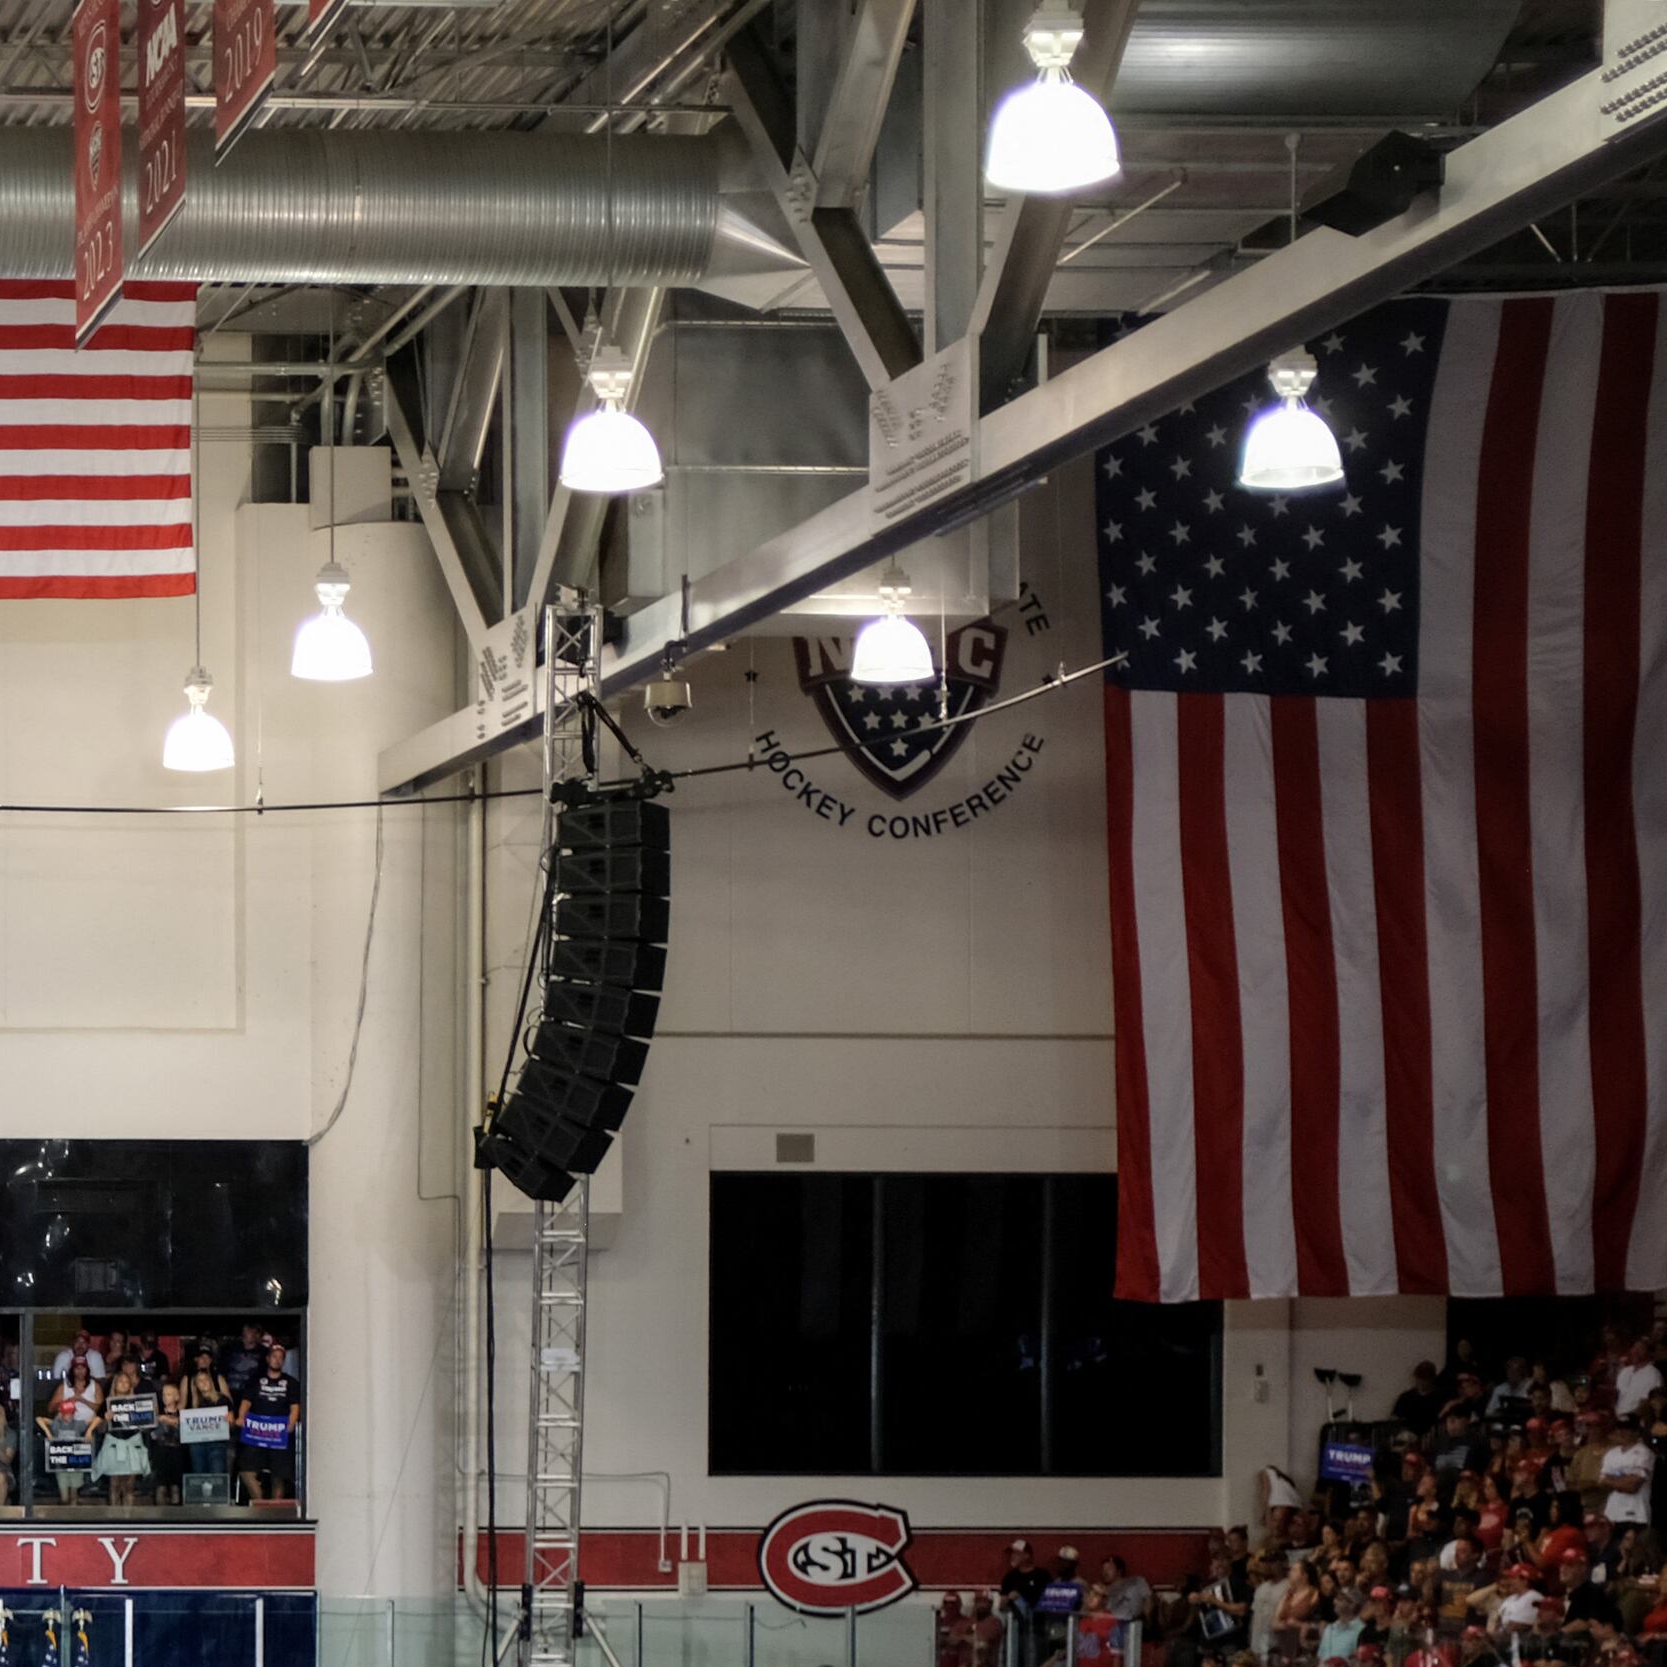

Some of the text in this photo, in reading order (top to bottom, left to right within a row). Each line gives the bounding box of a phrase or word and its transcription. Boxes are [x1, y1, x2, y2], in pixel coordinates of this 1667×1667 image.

[755, 729, 1045, 840] HOCKEY CONFERENCE
[111, 1403, 136, 1413] BACK
[113, 1413, 130, 1422] THE
[186, 1415, 222, 1425] TRUMP
[189, 1424, 220, 1433] VANCE
[245, 1417, 286, 1432] TRUMP
[49, 1445, 73, 1454] BACK
[50, 1455, 68, 1464] THE
[1328, 1449, 1372, 1465] TRUMP
